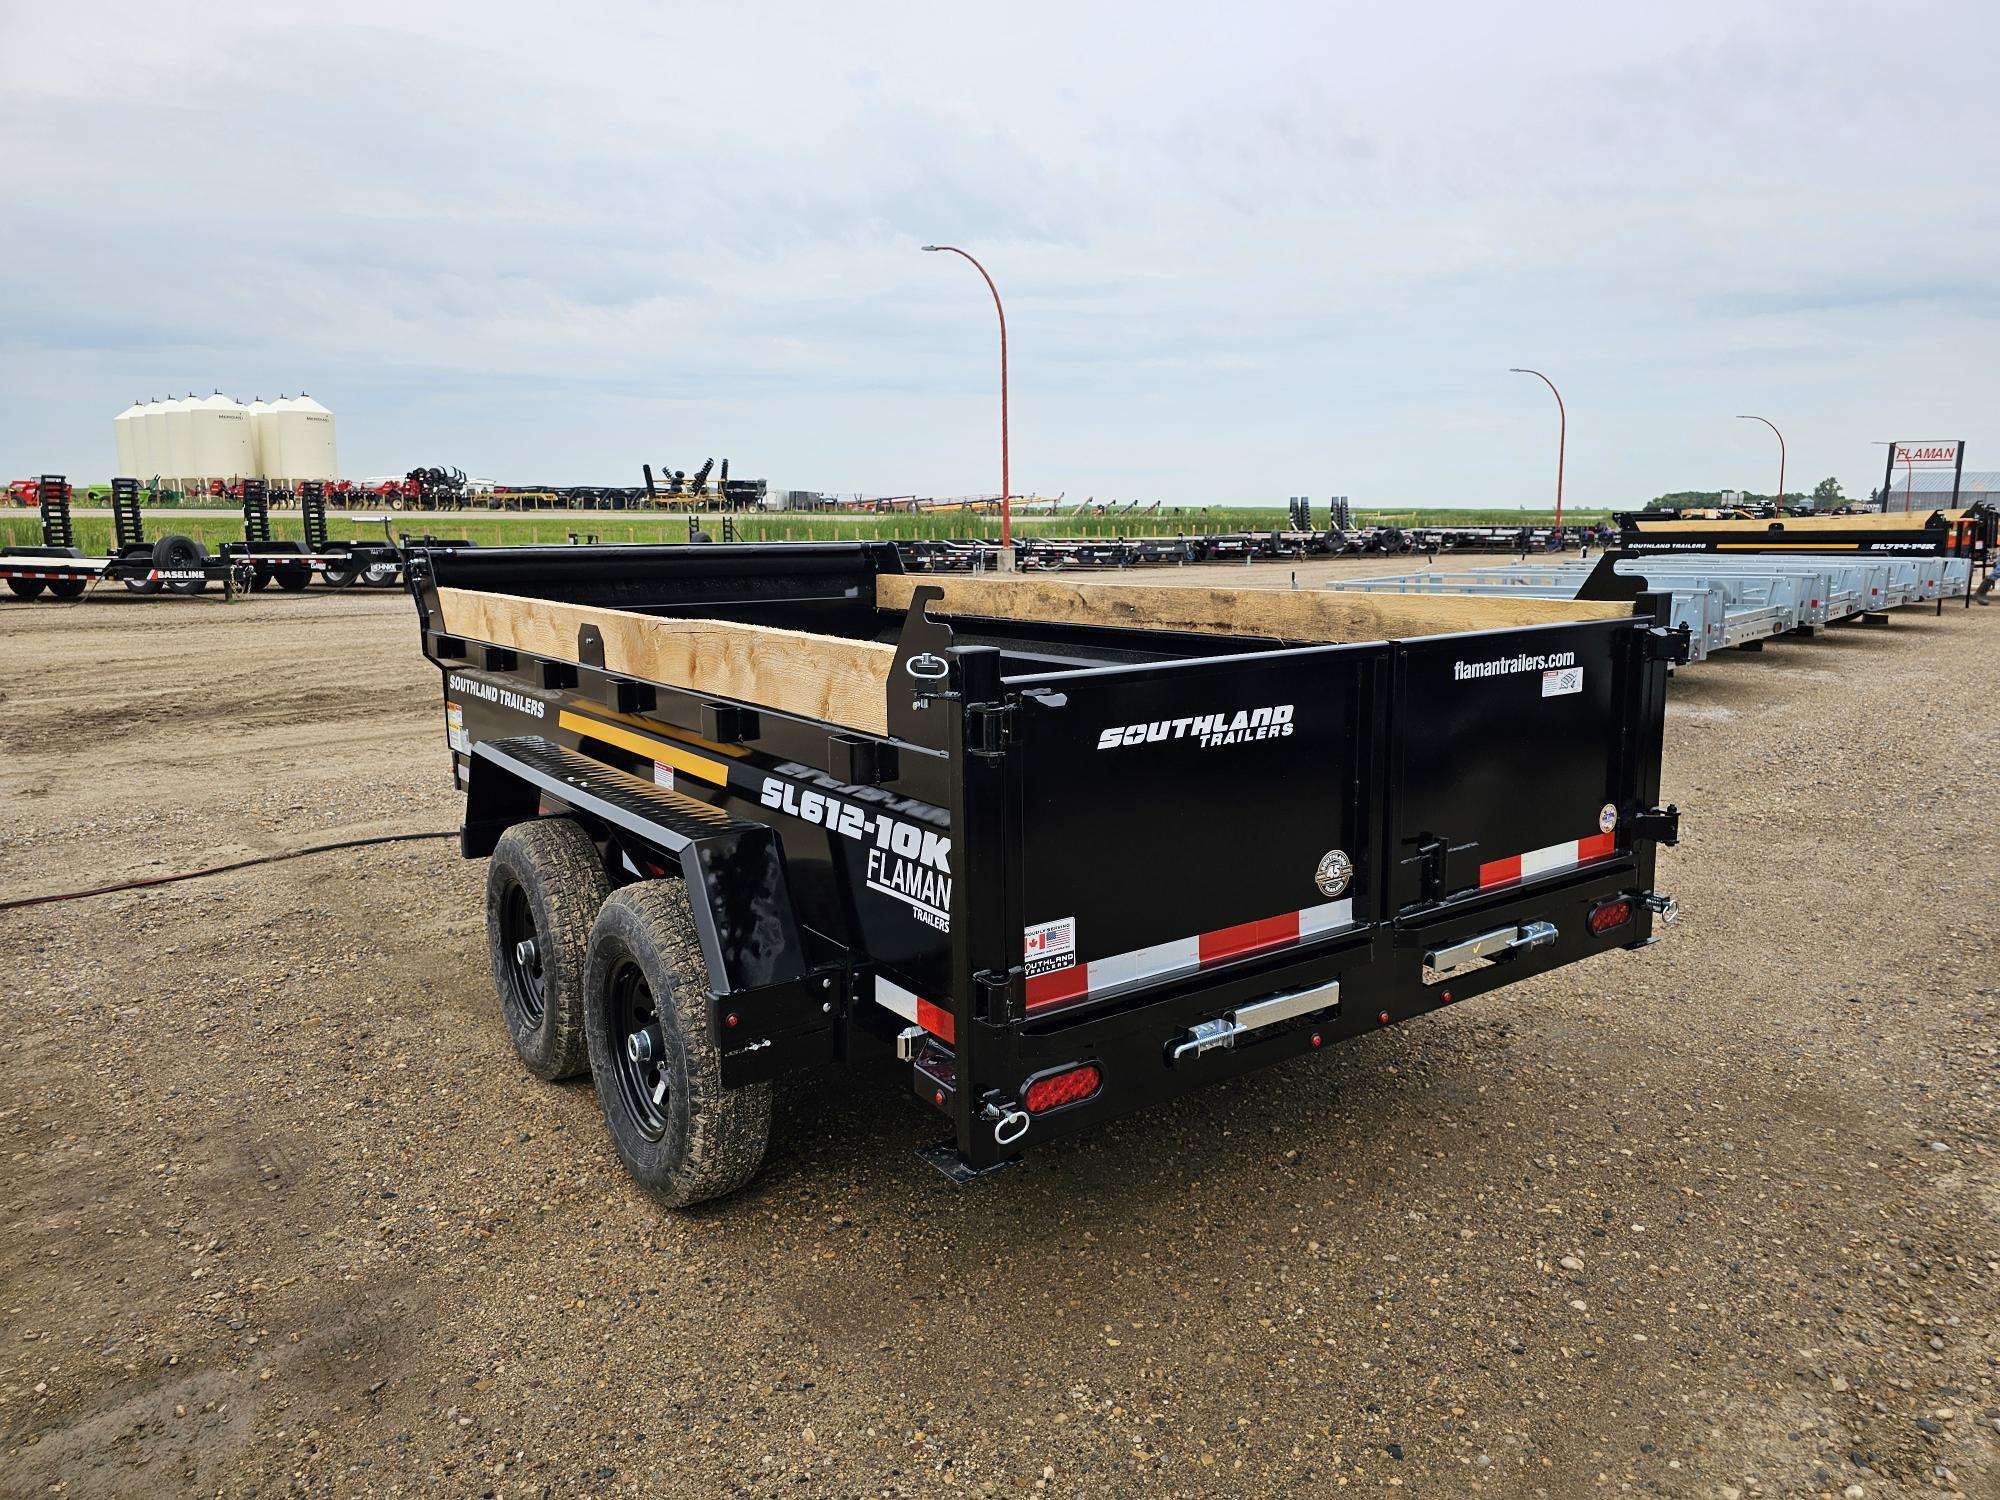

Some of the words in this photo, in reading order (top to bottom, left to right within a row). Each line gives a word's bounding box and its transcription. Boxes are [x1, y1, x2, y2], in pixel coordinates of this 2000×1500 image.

[1896, 447, 1956, 460] FLAMAN
[157, 570, 206, 579] BASELINE
[1454, 651, 1575, 681] flamantrailers.com
[449, 674, 498, 702] SOUTHLAND
[500, 689, 545, 719] TRAILERS
[1097, 704, 1295, 750] SOUTHLAND
[1200, 722, 1294, 748] TRAILERS
[760, 777, 952, 875] SL612-10K
[866, 848, 952, 911] FLAMAN
[912, 906, 950, 934] TRAILERS
[1024, 953, 1074, 972] OUTHLAND
